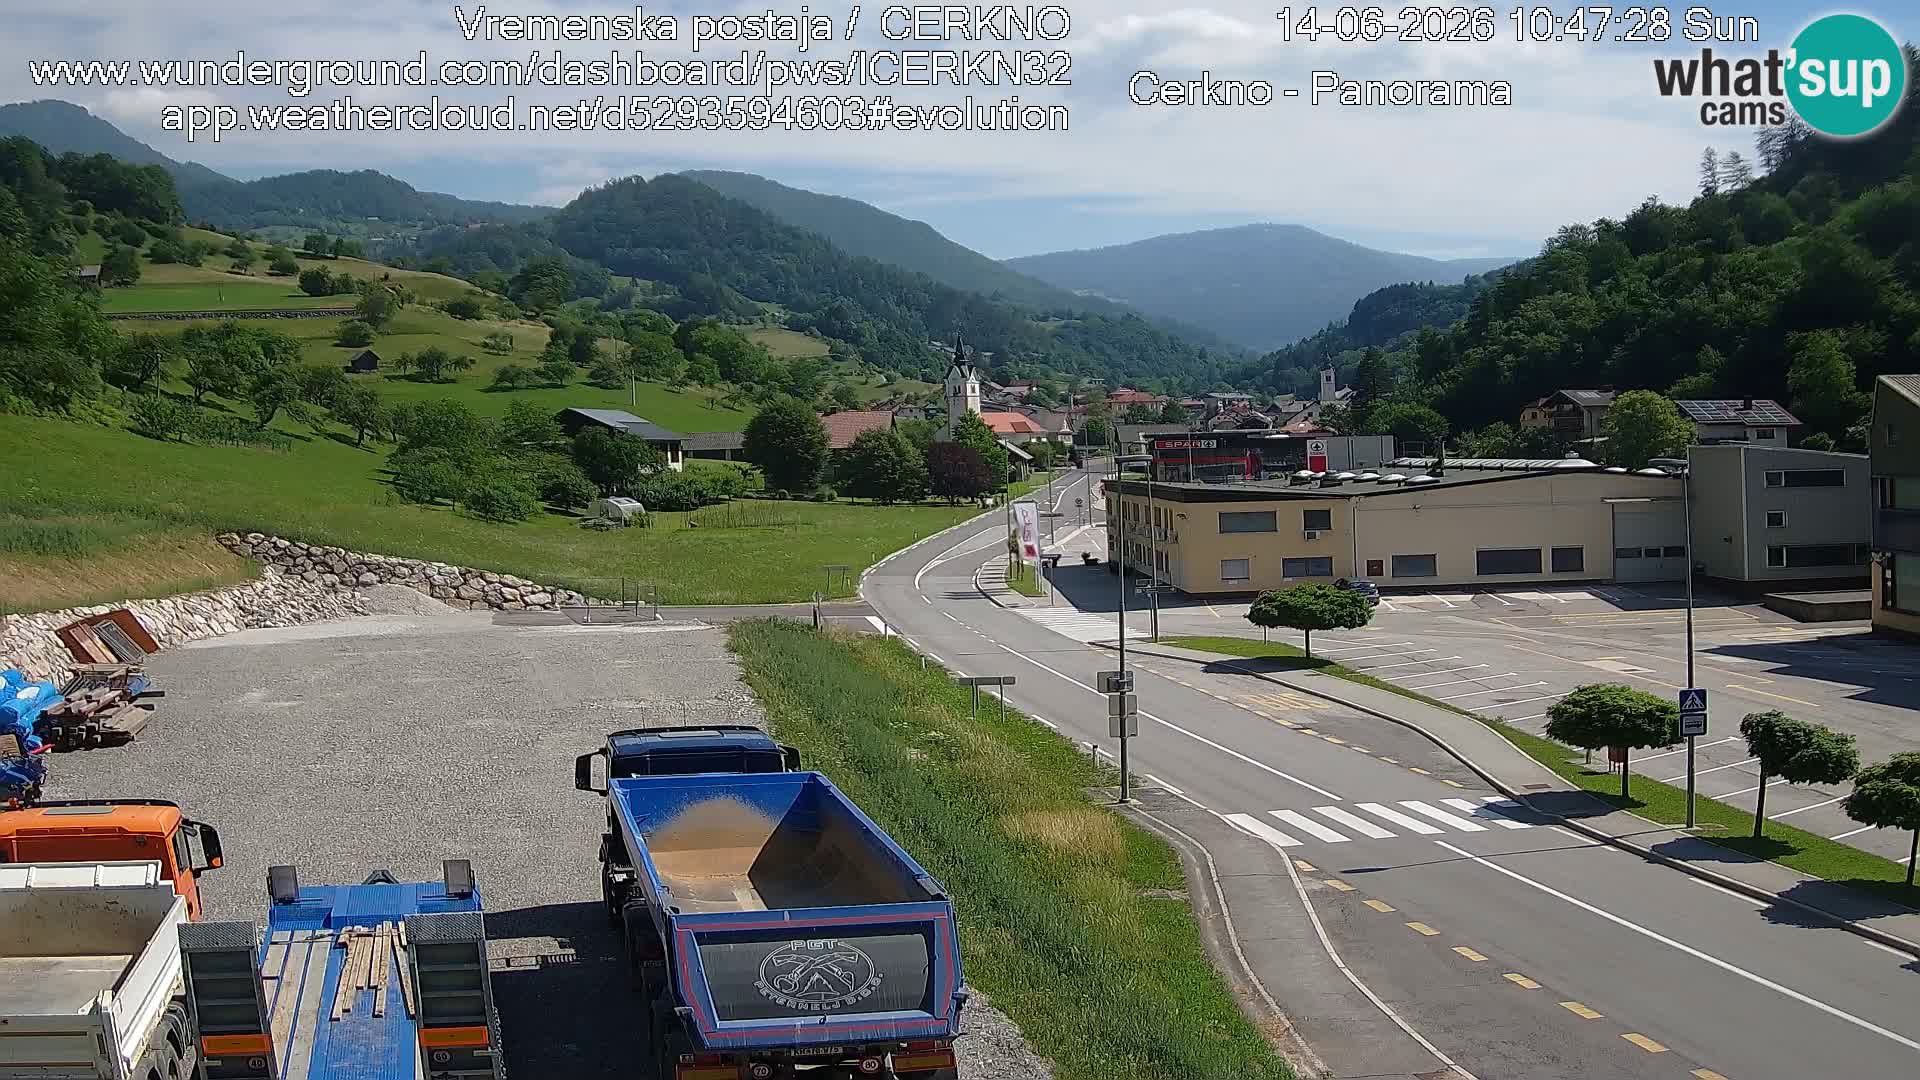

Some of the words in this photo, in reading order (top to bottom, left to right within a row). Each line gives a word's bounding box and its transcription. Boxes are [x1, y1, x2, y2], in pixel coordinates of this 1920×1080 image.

[790, 938, 838, 951] PGT
[865, 1060, 879, 1069] 80
[754, 1066, 768, 1075] 70
